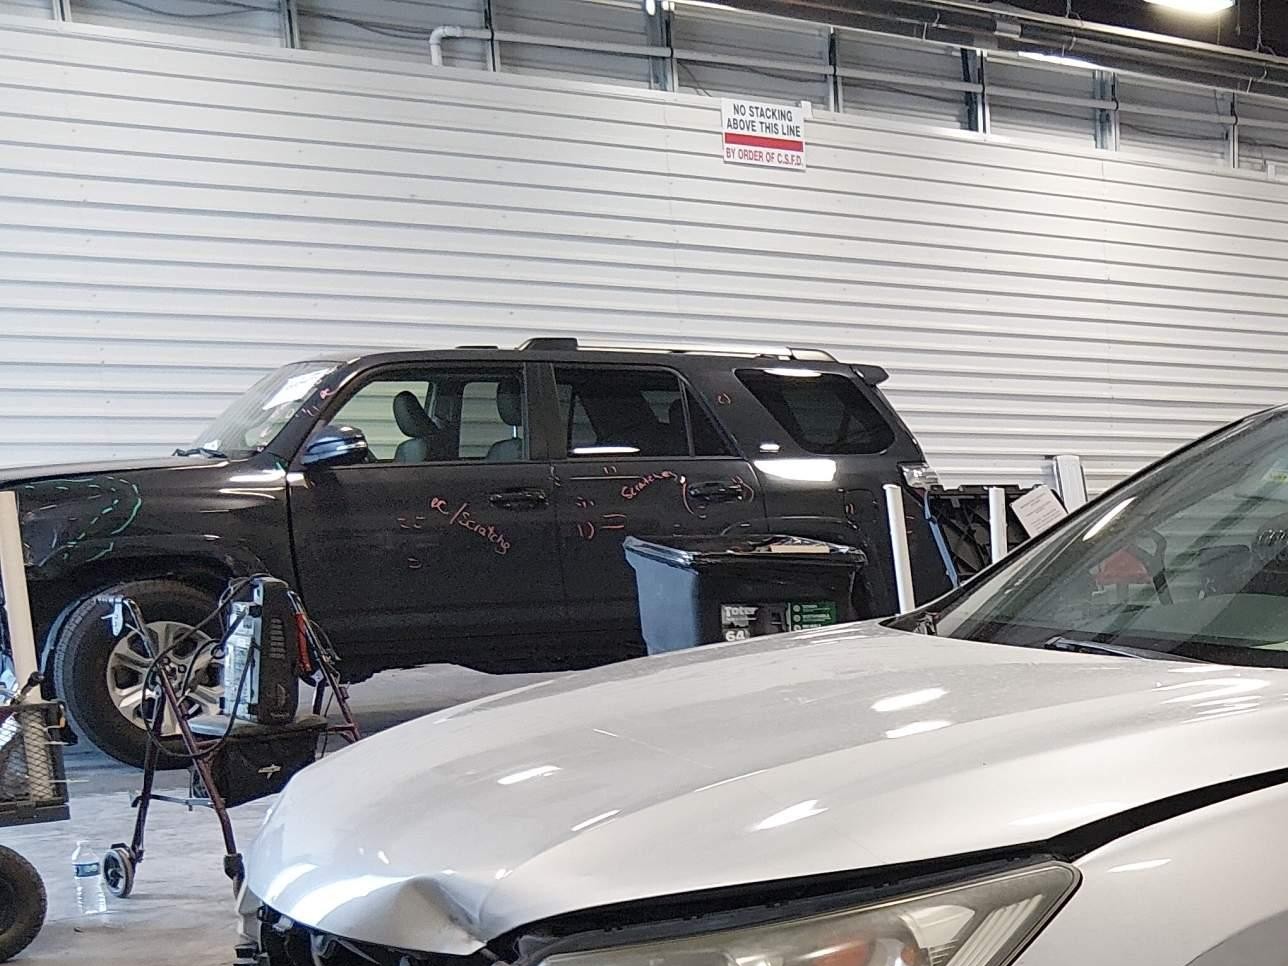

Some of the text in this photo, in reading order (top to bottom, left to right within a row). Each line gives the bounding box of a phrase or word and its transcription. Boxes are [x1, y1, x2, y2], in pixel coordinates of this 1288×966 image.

[733, 104, 793, 121] NO STACKING
[726, 118, 801, 137] ABOVE THIS LINE
[726, 147, 736, 158] BY
[738, 149, 763, 161] ORDER
[765, 152, 775, 162] OF
[725, 630, 746, 641] 64
